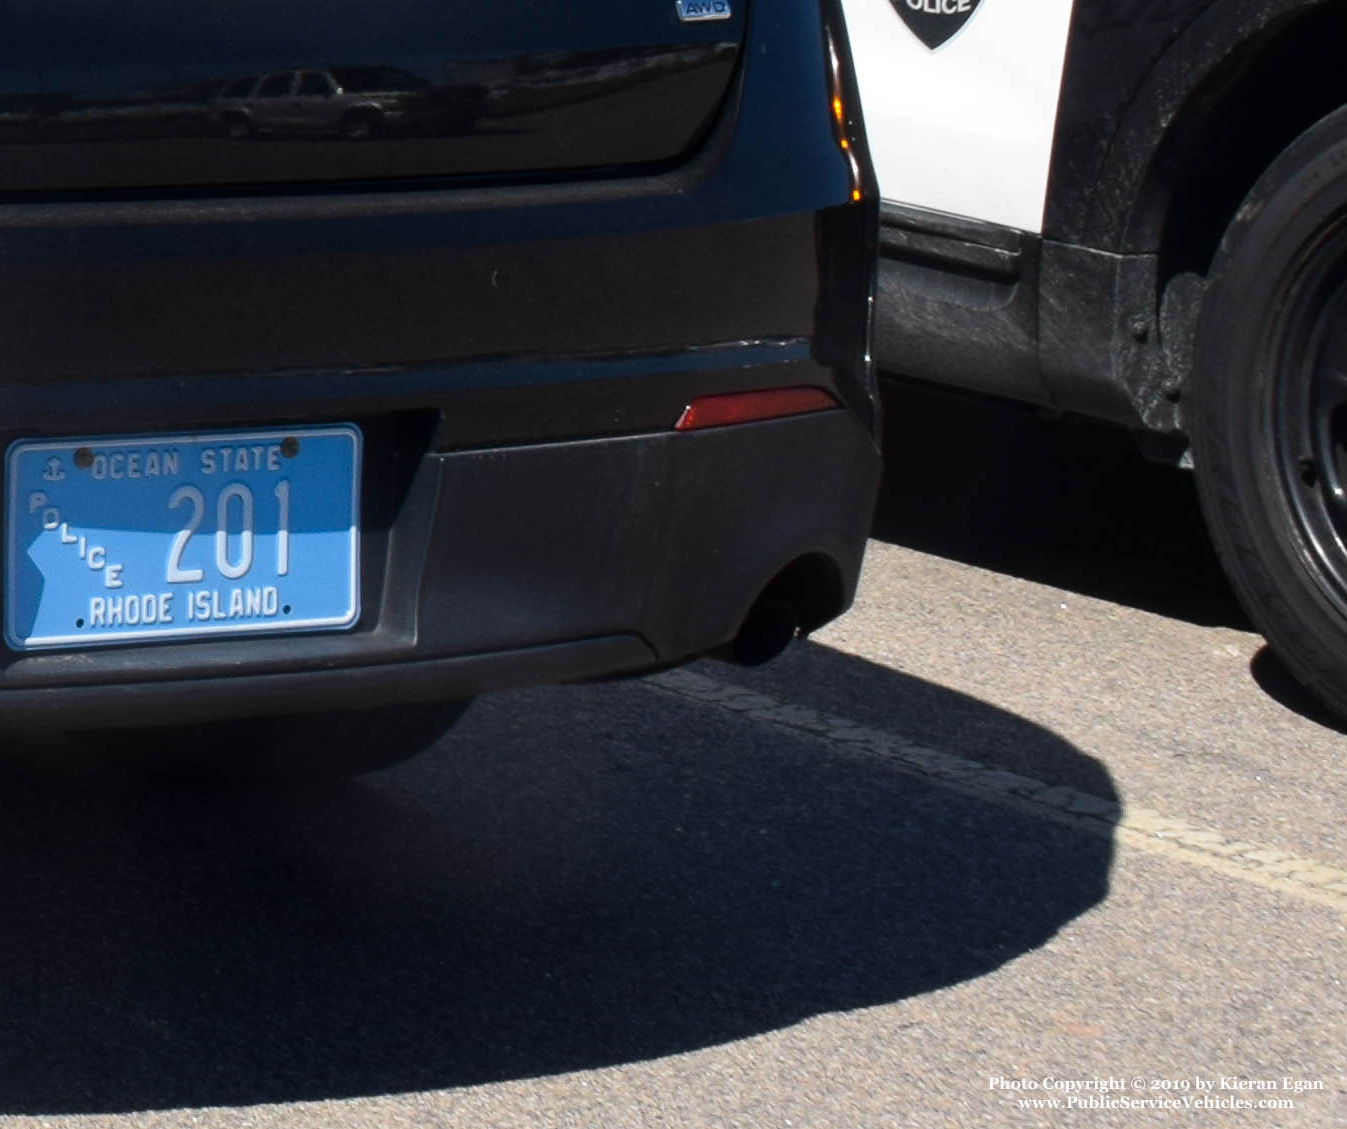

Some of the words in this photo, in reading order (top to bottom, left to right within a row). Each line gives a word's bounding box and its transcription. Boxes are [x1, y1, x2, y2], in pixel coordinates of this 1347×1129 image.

[686, 0, 725, 15] AWD
[91, 449, 179, 481] OCEAN
[201, 444, 281, 475] STATE
[28, 490, 124, 589] POLICE
[166, 478, 290, 584] 201
[89, 592, 173, 628] RHODE
[188, 586, 279, 621] ISLAND
